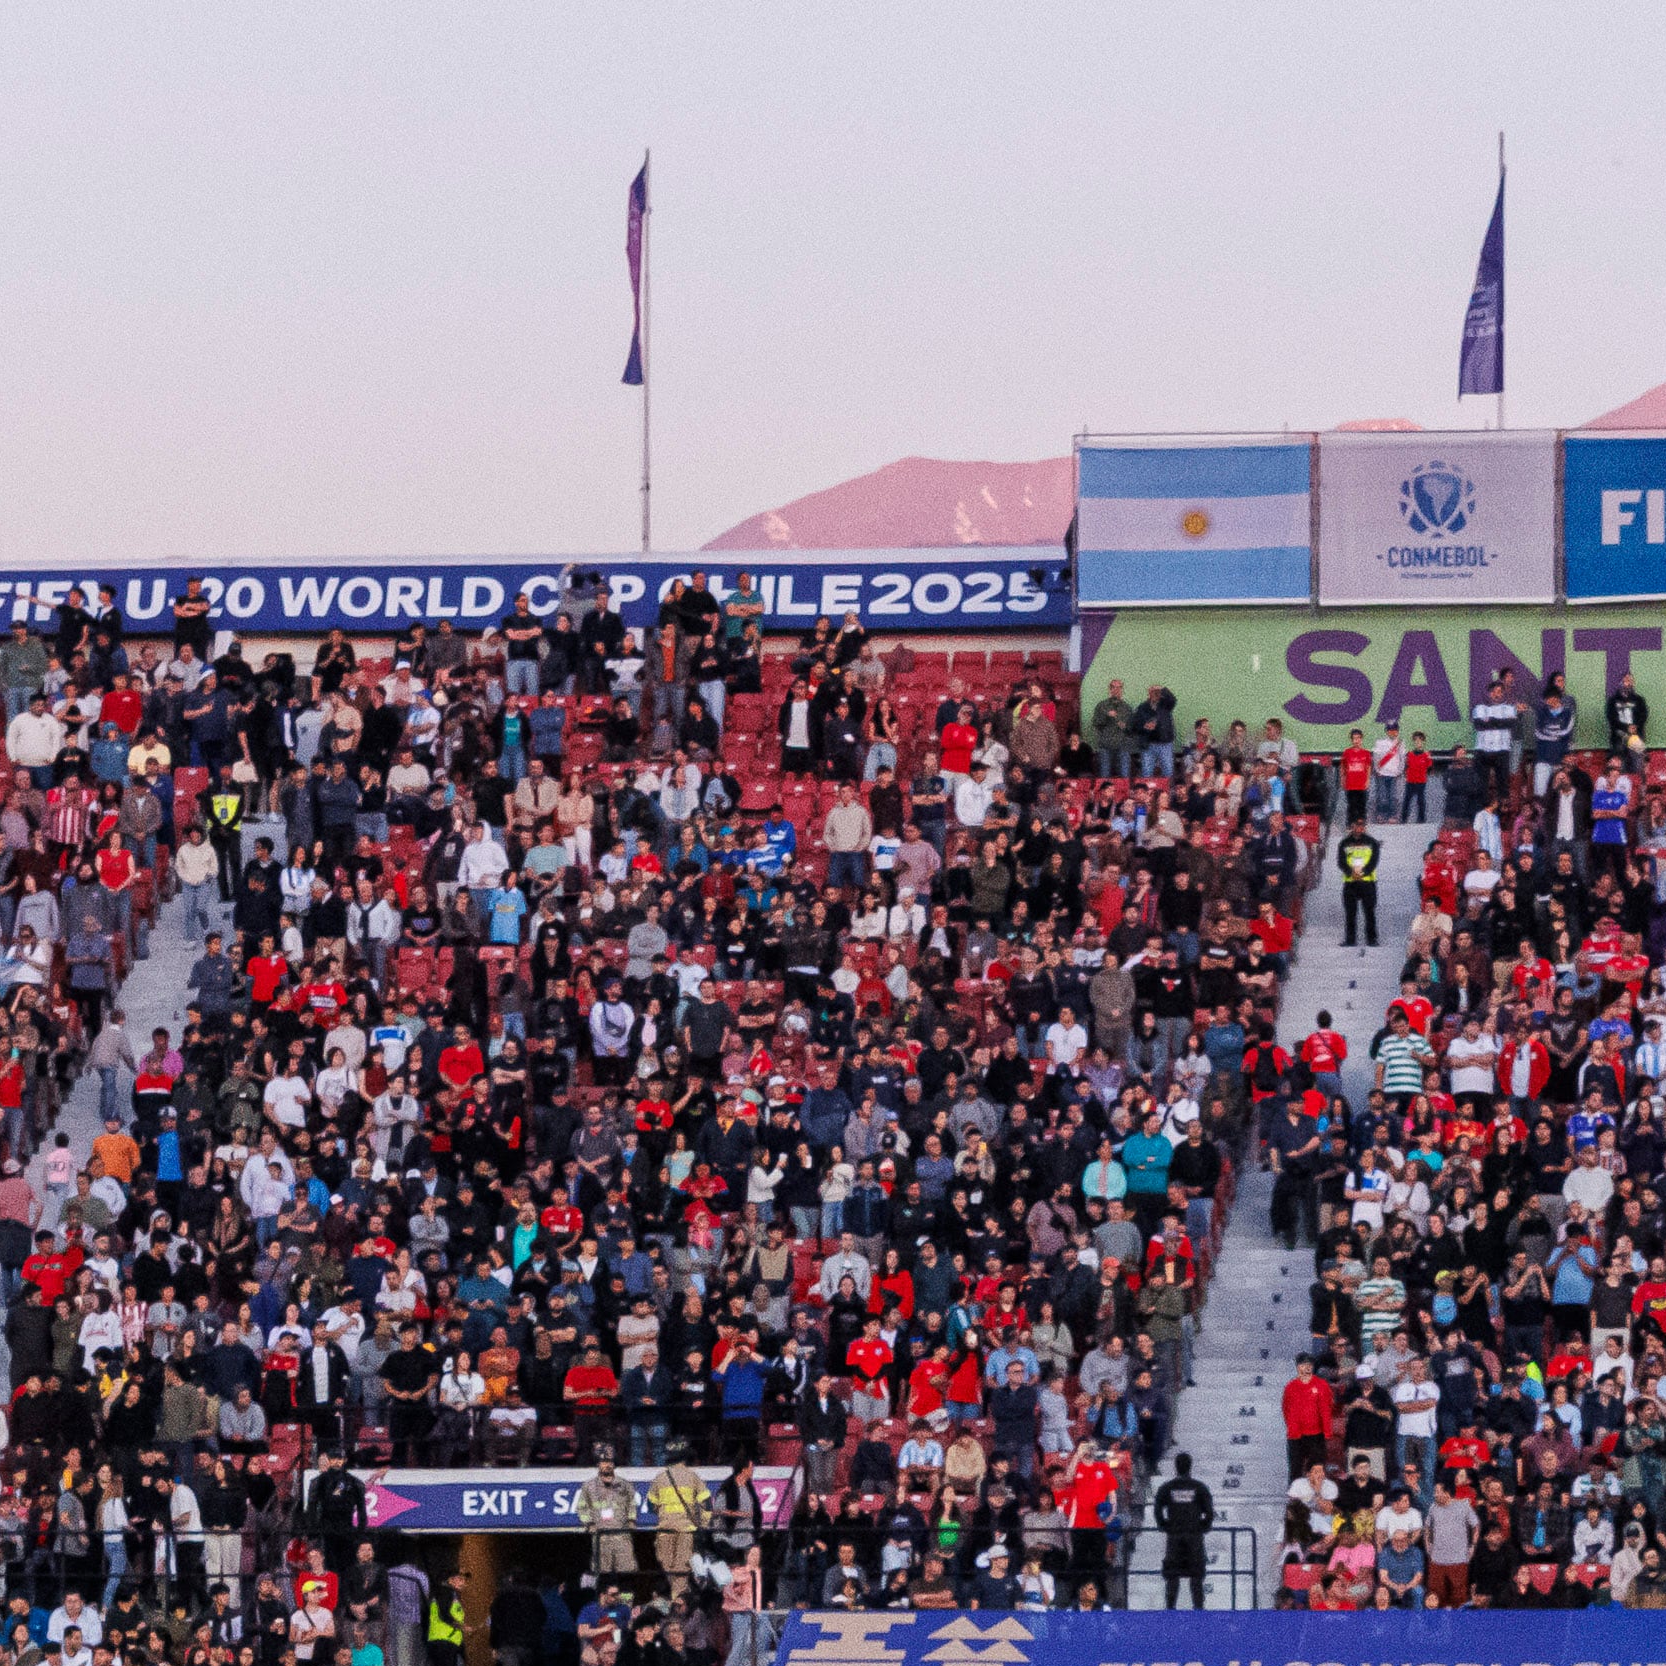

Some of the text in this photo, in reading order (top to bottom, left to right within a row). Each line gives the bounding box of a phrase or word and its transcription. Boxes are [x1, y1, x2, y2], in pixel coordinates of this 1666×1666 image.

[1388, 546, 1489, 568] CONMEBOL
[278, 575, 505, 618] WORLD
[520, 575, 646, 617] CP
[869, 572, 1049, 615] 2025
[462, 1489, 528, 1516] EXIT
